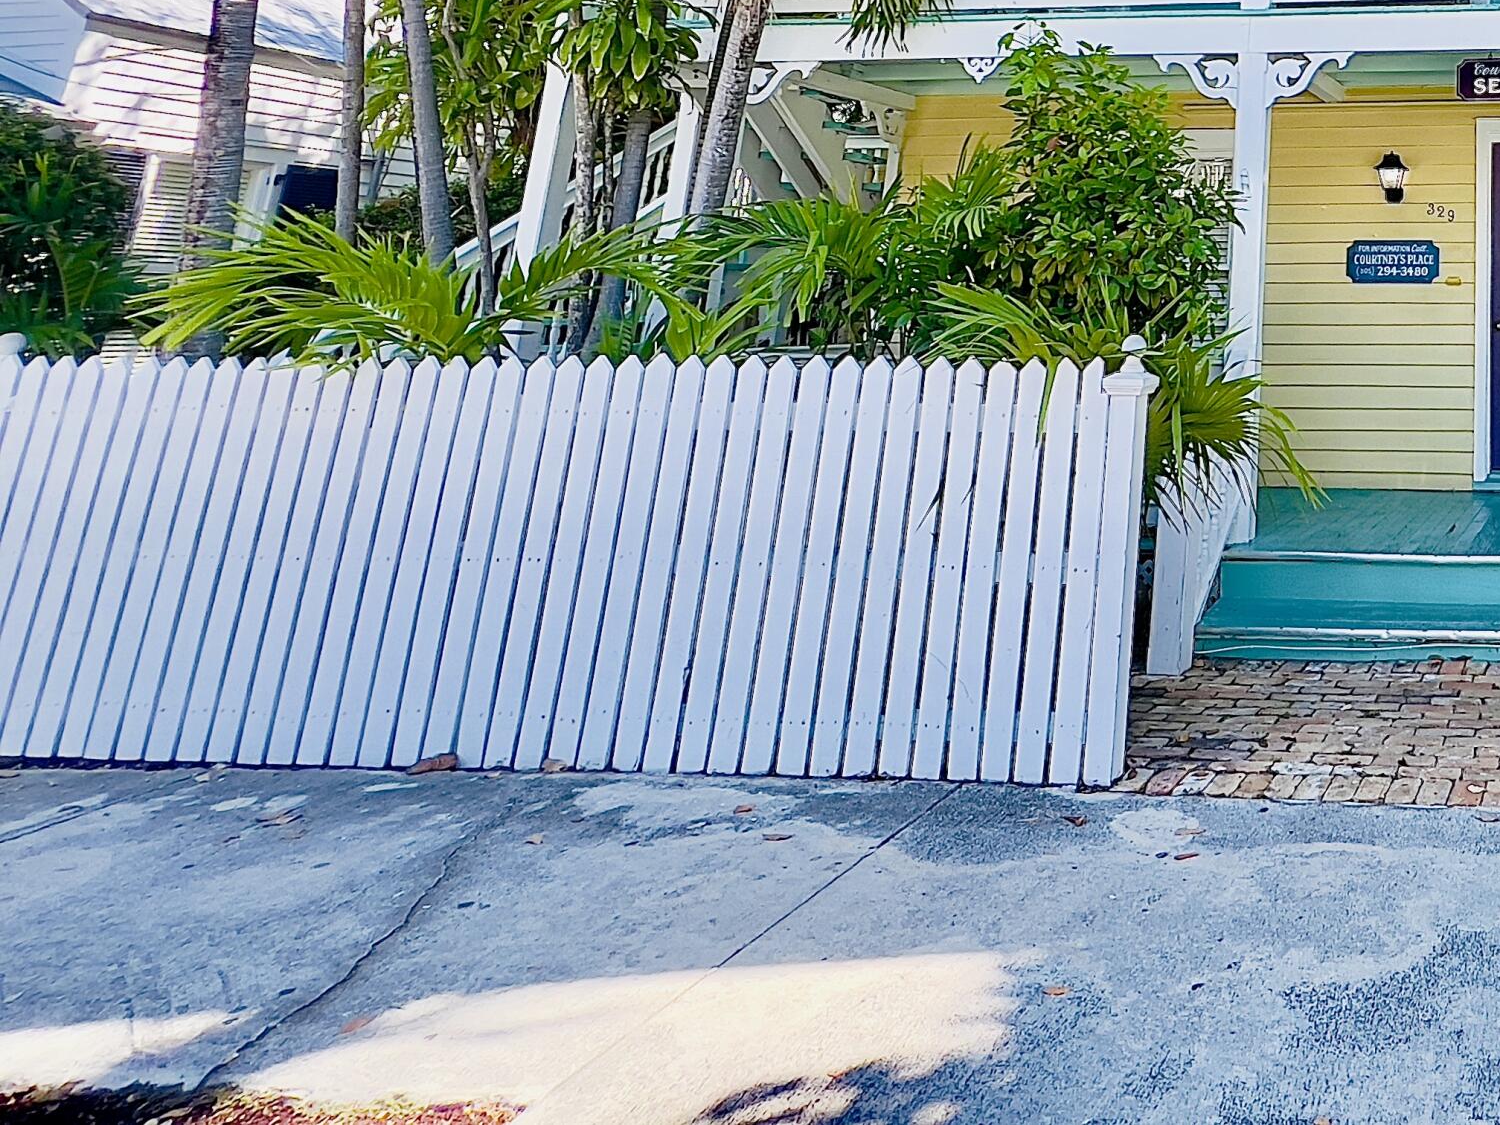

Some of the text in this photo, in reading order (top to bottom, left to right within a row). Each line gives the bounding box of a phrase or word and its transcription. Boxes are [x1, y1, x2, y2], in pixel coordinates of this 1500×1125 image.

[1426, 202, 1455, 223] 329
[1354, 254, 1434, 265] COURTNEY'S PLACE
[1377, 266, 1429, 276] 294-3480
